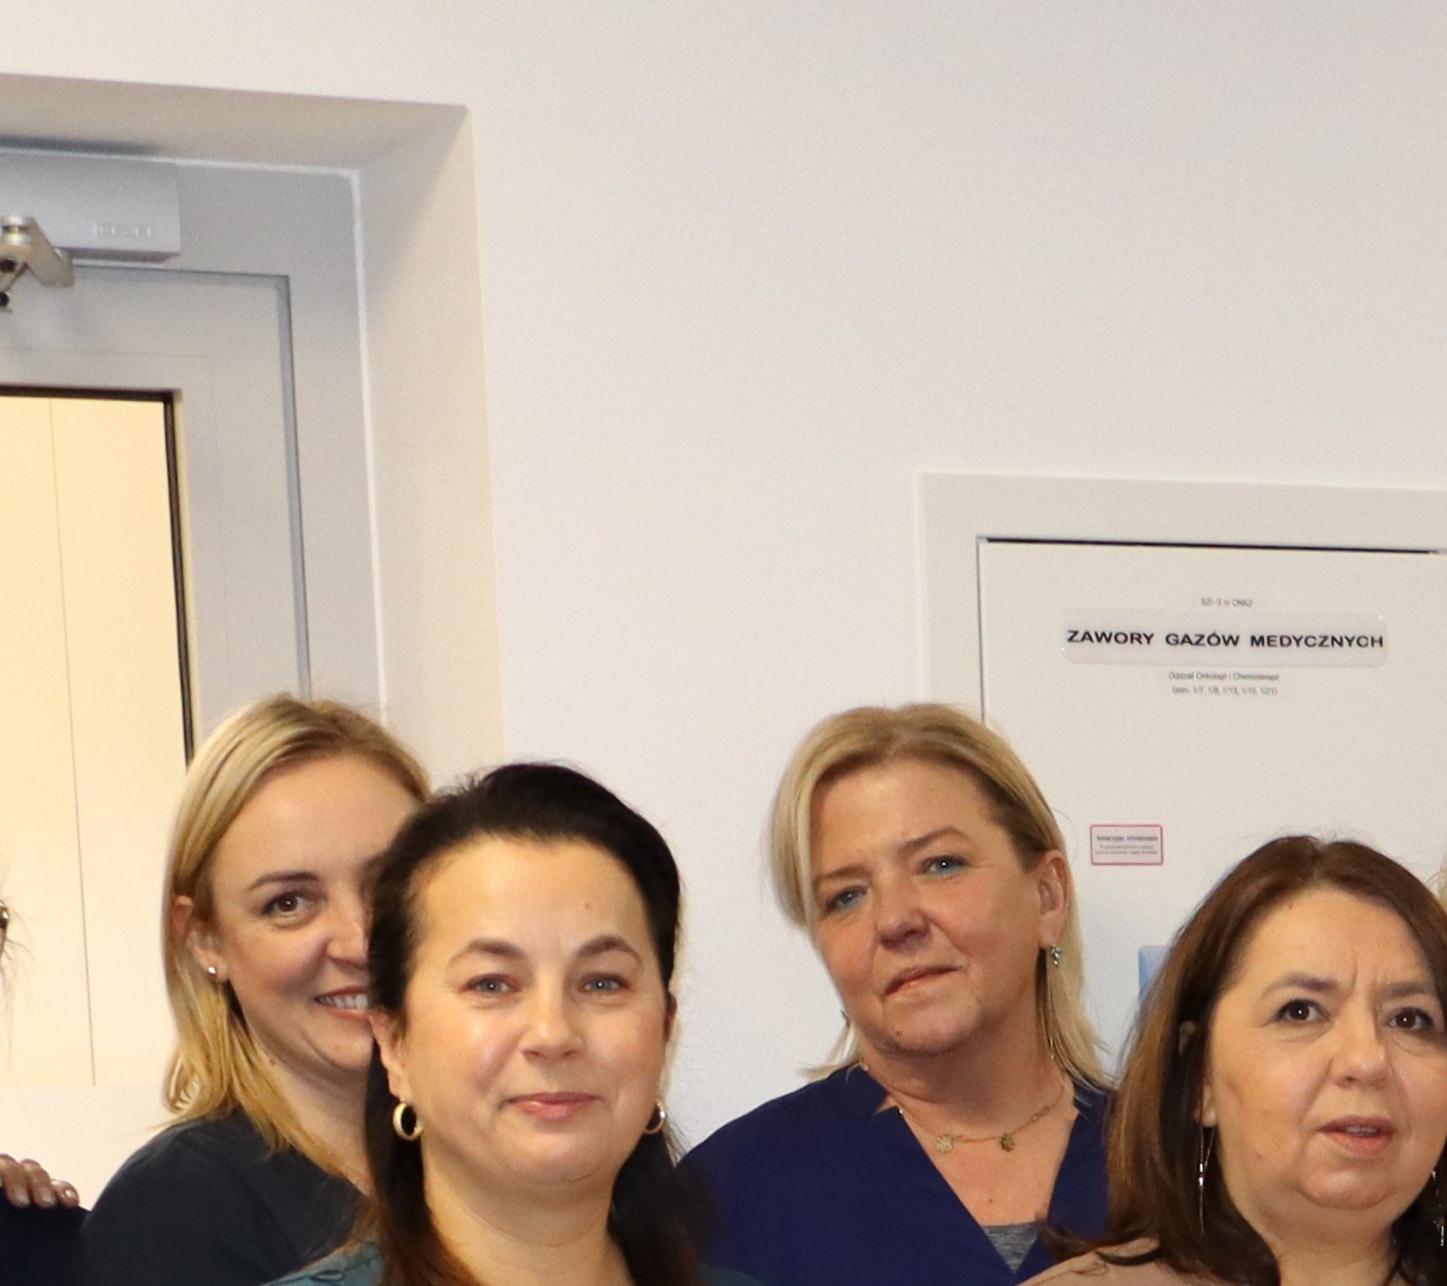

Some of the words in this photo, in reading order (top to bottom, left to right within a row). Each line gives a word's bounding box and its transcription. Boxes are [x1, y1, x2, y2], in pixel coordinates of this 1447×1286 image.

[1067, 630, 1155, 645] ZAWORY
[1165, 632, 1240, 647] GAZÓW
[1250, 635, 1383, 648] MEDYCZNYCH
